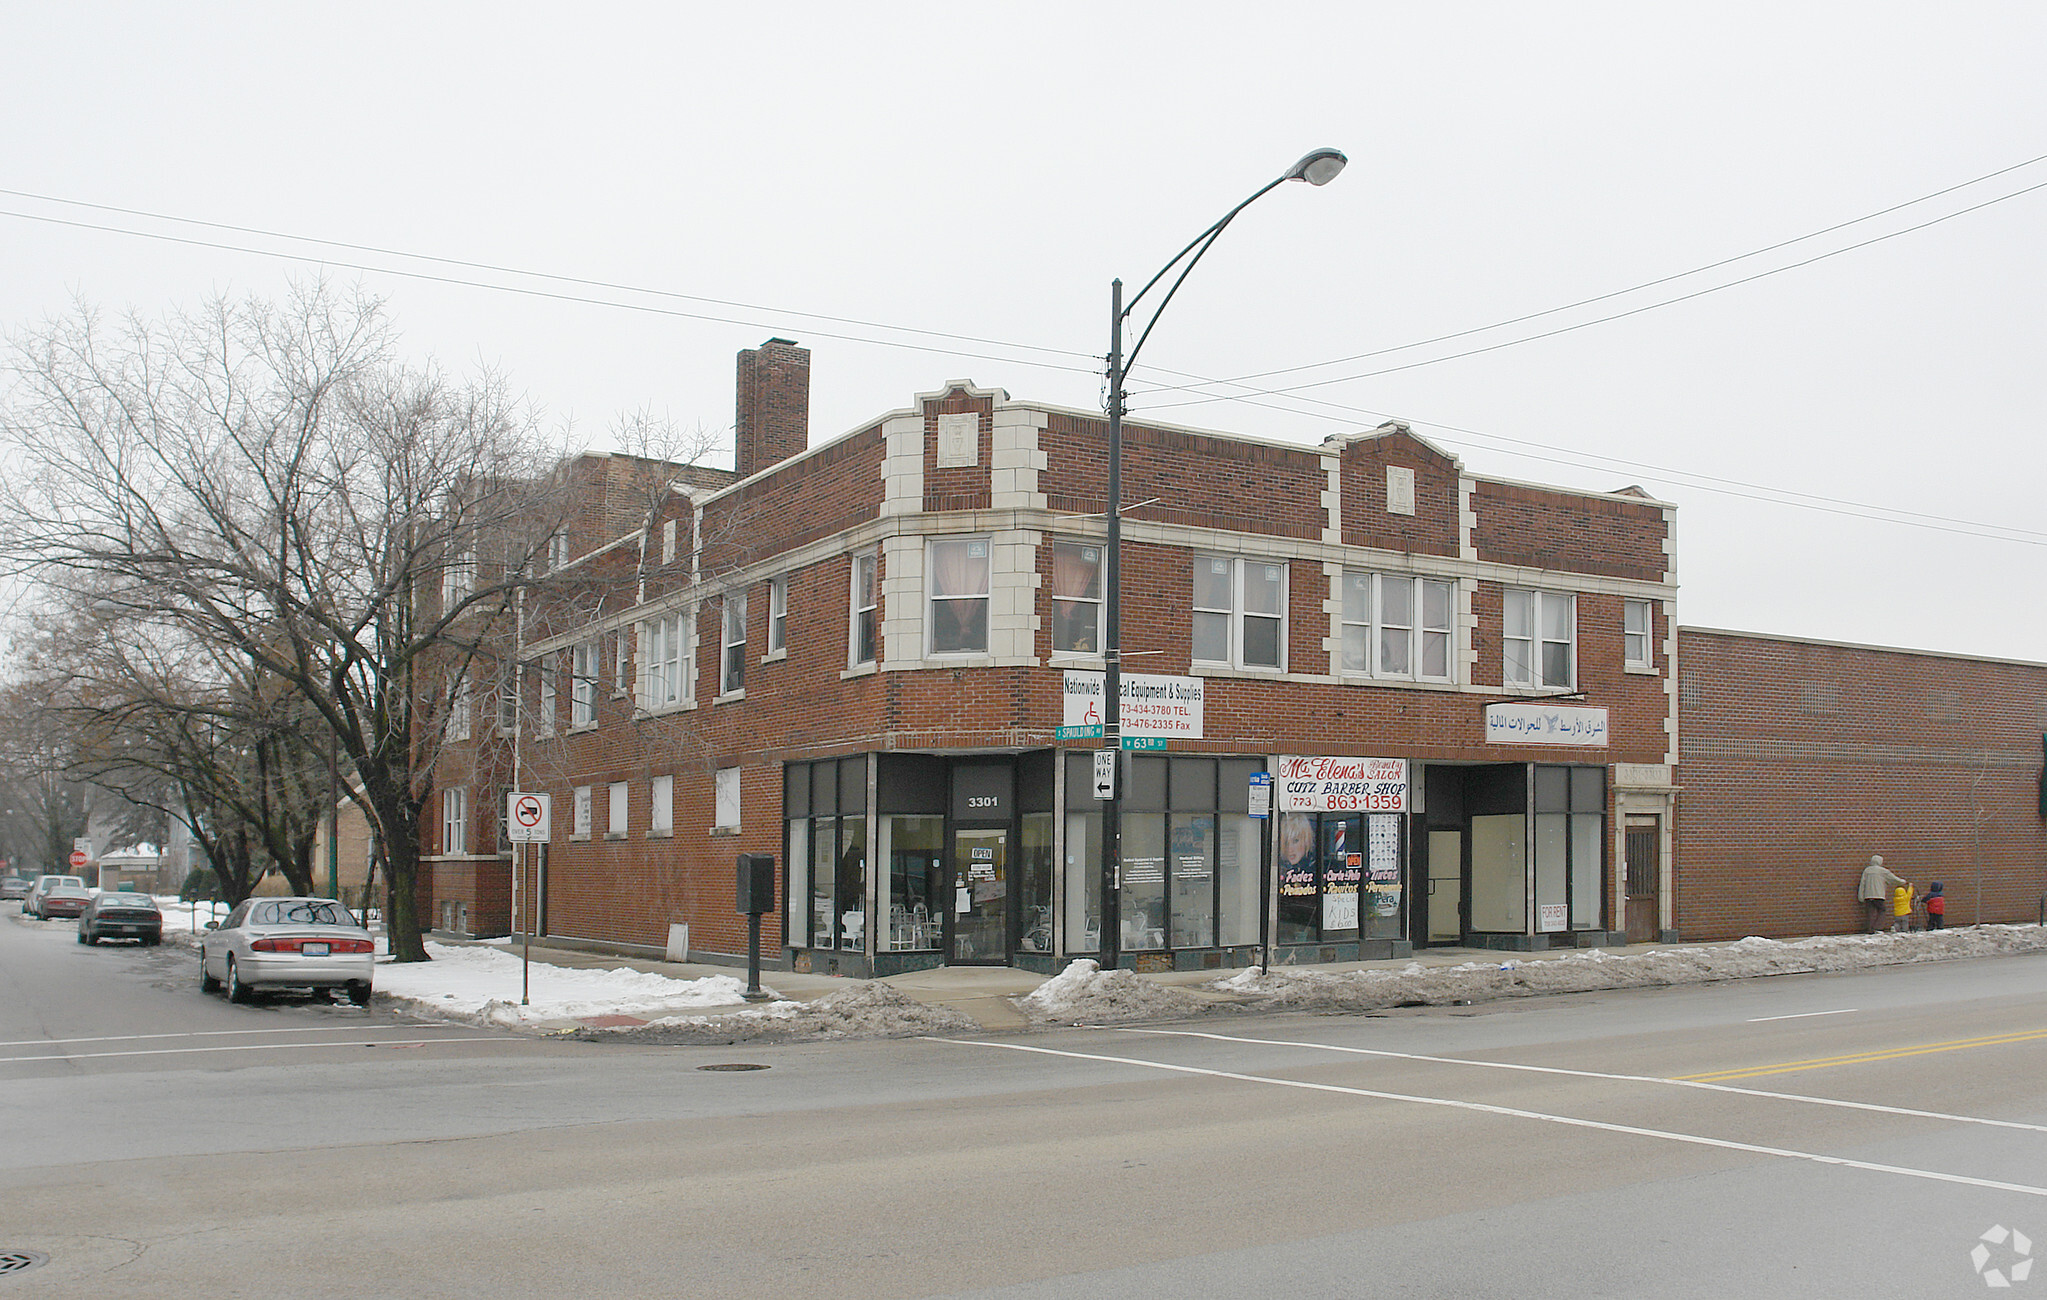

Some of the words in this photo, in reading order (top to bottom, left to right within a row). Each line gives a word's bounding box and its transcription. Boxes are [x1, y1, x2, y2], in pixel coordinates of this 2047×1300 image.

[1064, 677, 1100, 696] Nationwide
[1131, 680, 1167, 702] Equipment
[1168, 683, 1174, 699] &
[1175, 683, 1202, 704] Supplies
[1120, 703, 1171, 716] 73-434-3780
[1173, 706, 1191, 716] TEL.
[1120, 718, 1173, 730] 73-476-2335
[1175, 721, 1191, 731] Fax
[1062, 726, 1095, 738] SPAULDING
[1096, 754, 1112, 766] ONE
[1095, 767, 1112, 778] WAY
[1311, 757, 1364, 780] Elena's
[1367, 770, 1402, 780] SALON
[1287, 781, 1317, 793] CUTZ
[1321, 781, 1371, 796] BARBER
[1374, 782, 1406, 795] SHOP
[968, 796, 998, 808] 3301
[1289, 794, 1318, 810] (773)
[72, 855, 86, 863] STOP
[973, 849, 991, 858] OPEN
[1328, 905, 1357, 920] KIDS
[1542, 906, 1553, 919] FOR
[1553, 905, 1567, 918] RENT
